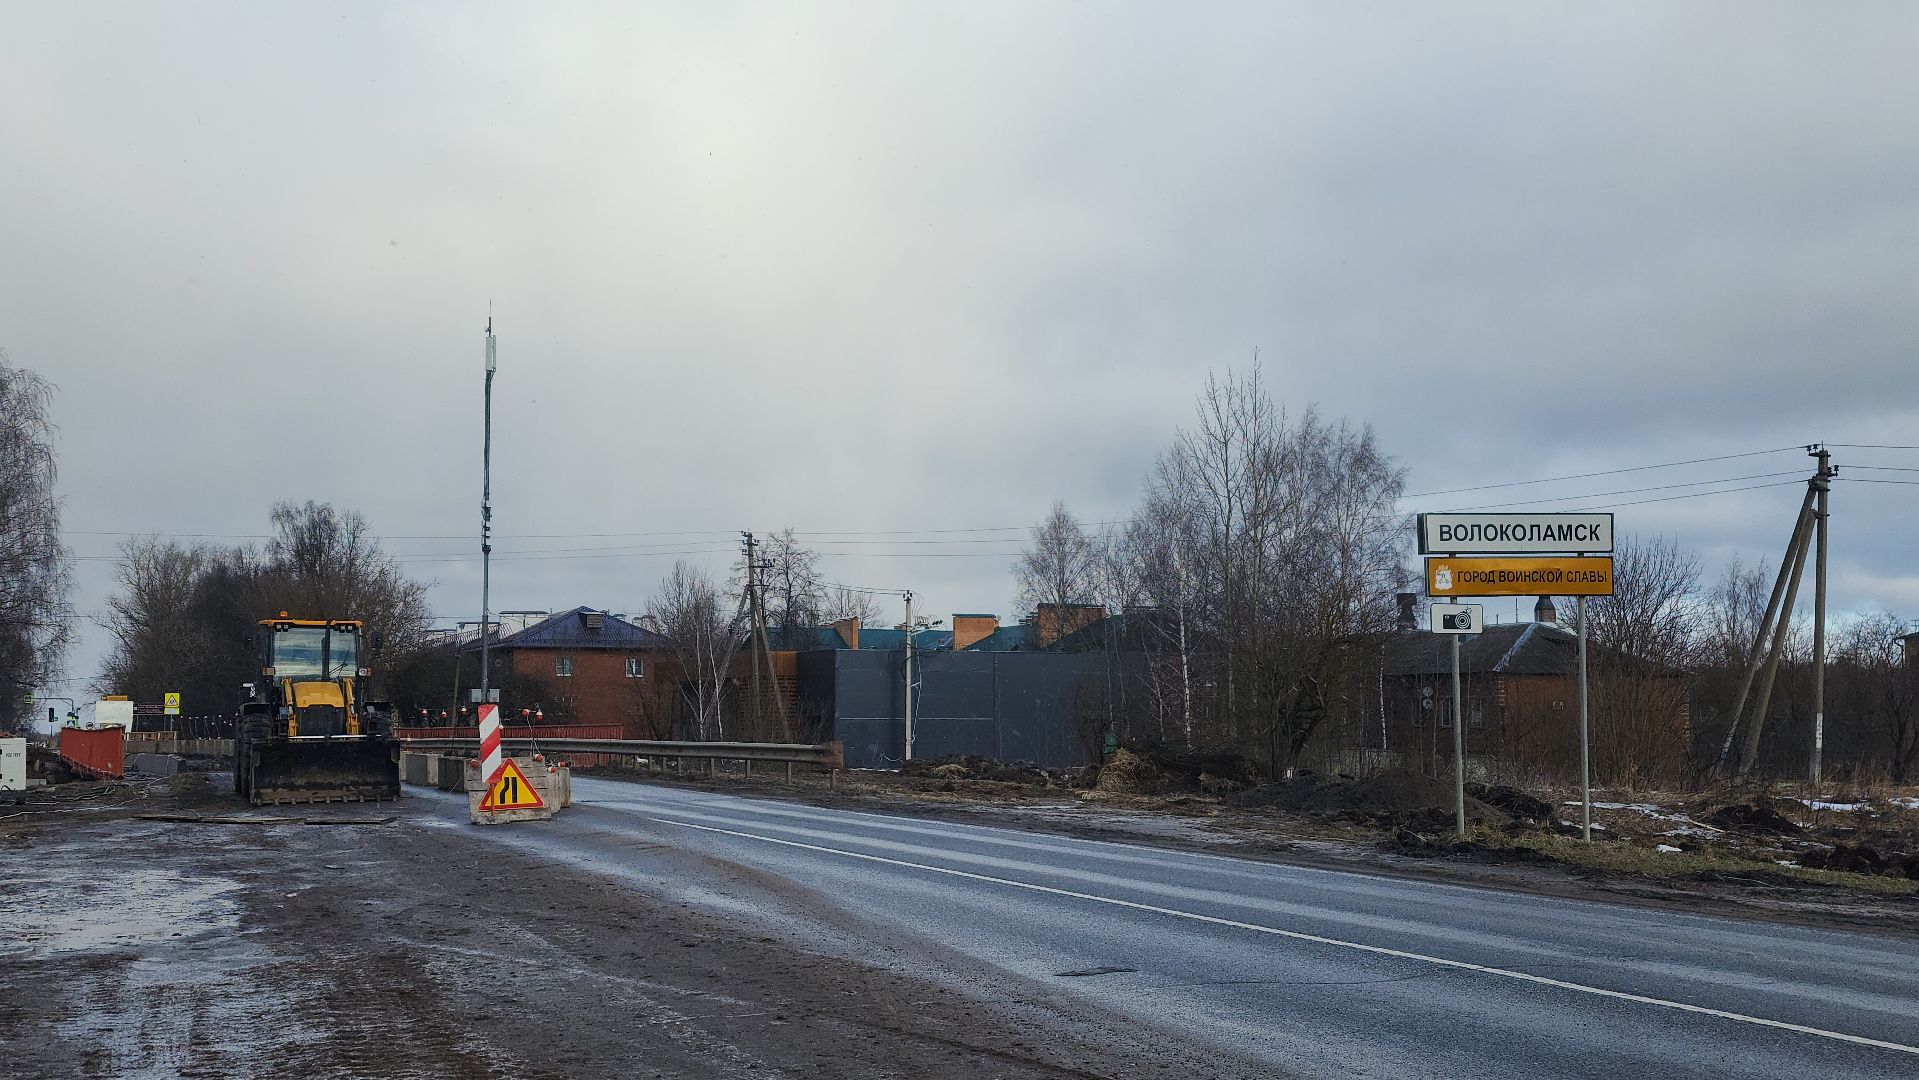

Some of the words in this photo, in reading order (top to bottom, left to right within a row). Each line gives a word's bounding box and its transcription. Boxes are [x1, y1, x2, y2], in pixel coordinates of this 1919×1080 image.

[1439, 524, 1601, 542] ВОЛОКОЛАМСК
[1457, 570, 1495, 584] ГОРОД
[1498, 568, 1563, 583] ВОИНСКОЙ
[1566, 570, 1607, 583] СЛАВЫ
